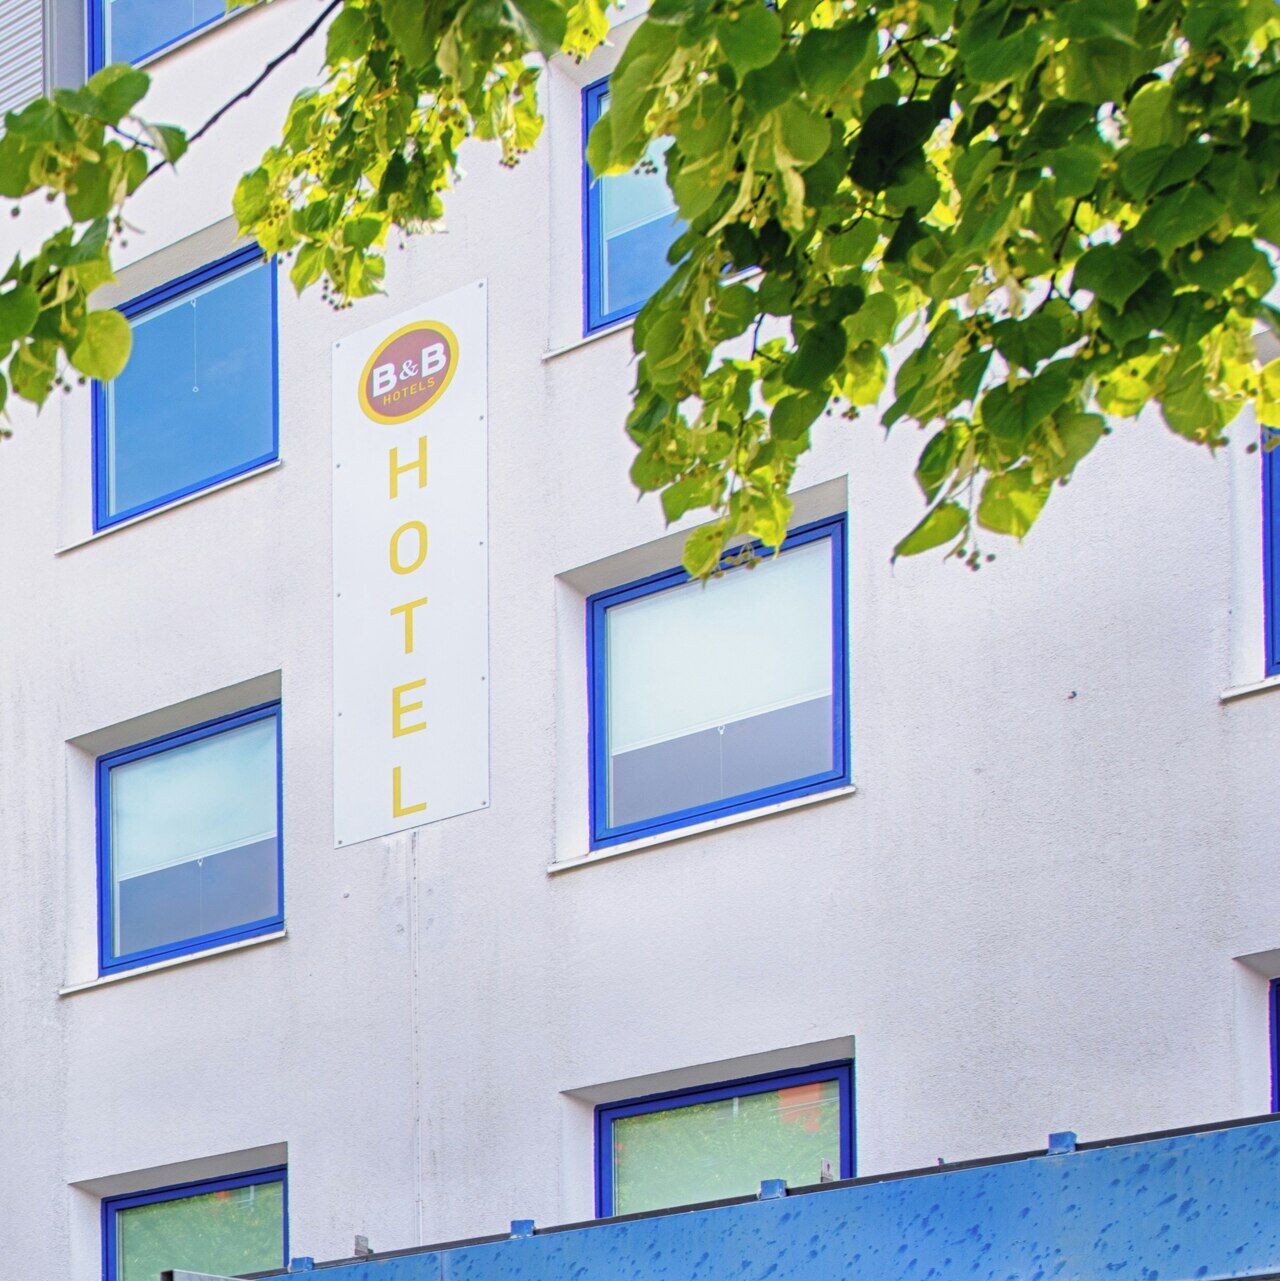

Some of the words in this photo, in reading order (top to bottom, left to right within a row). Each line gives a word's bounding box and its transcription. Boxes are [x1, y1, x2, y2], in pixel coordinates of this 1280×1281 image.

[372, 342, 447, 398] B&B
[383, 376, 436, 405] HOTELS
[388, 435, 429, 818] HOTEL
